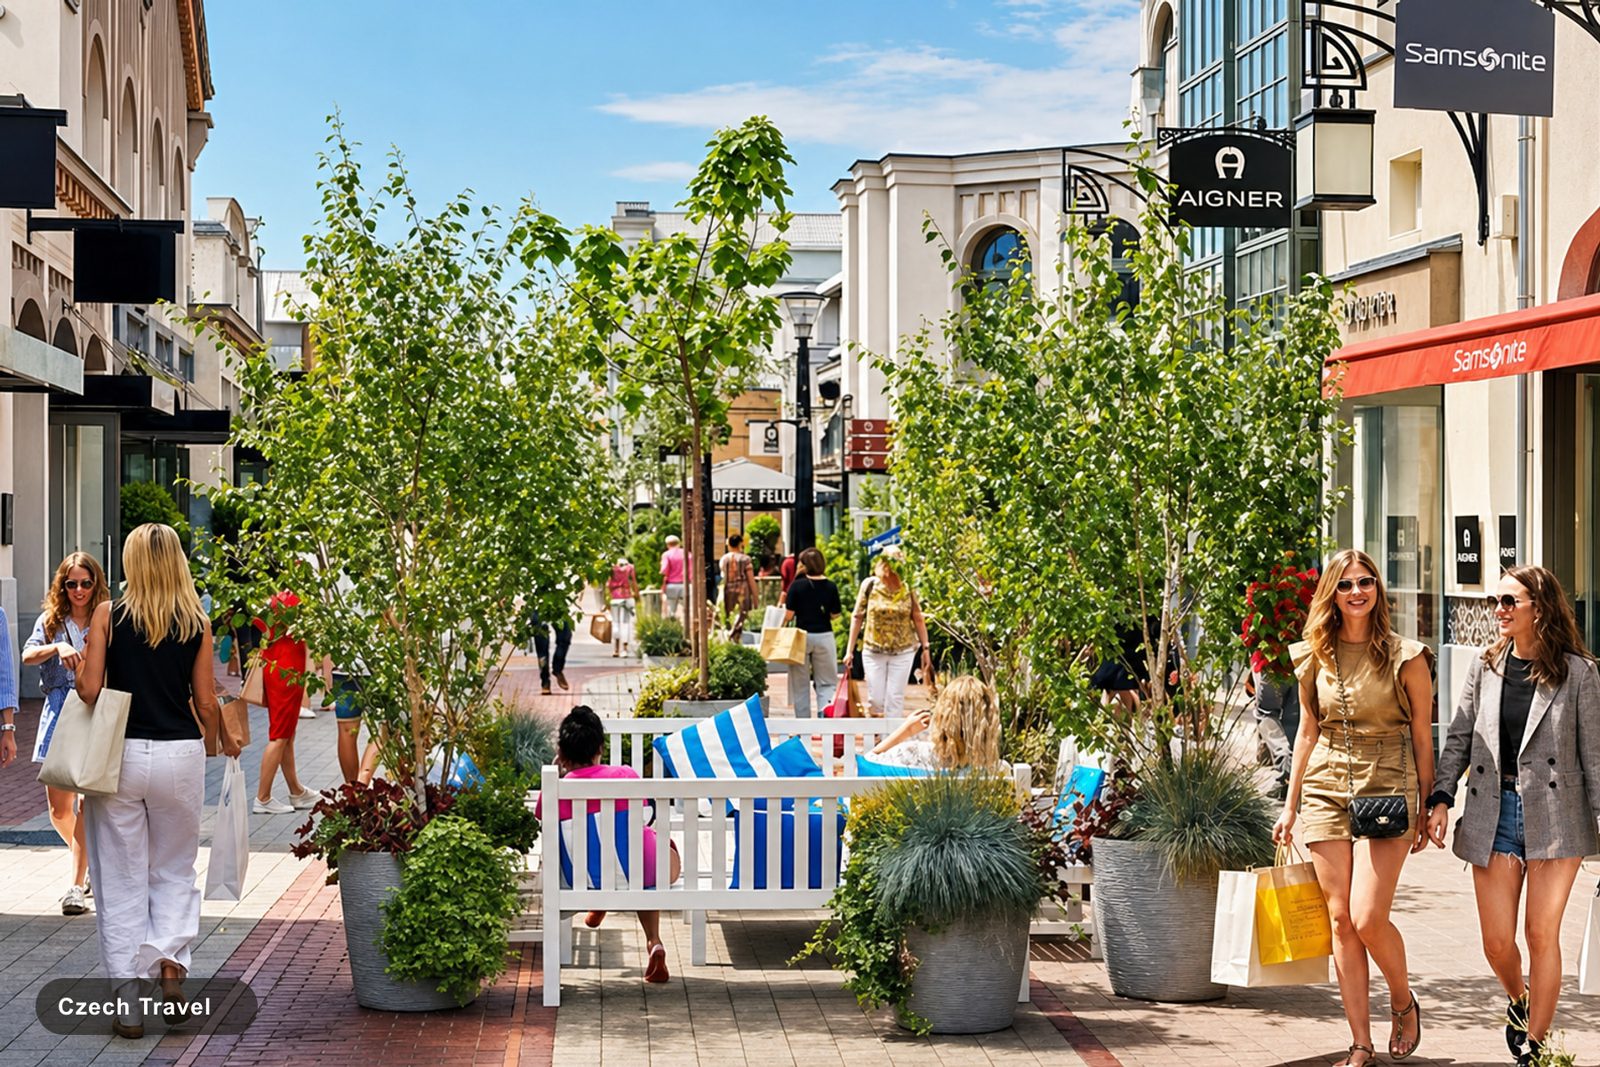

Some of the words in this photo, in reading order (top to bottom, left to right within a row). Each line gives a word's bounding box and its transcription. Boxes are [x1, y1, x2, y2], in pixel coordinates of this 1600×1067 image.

[1404, 42, 1547, 73] Samsonite
[1177, 189, 1284, 209] AIGNER
[1452, 339, 1528, 373] Samsonite
[712, 488, 753, 504] OFFEE
[758, 488, 797, 504] FELLO
